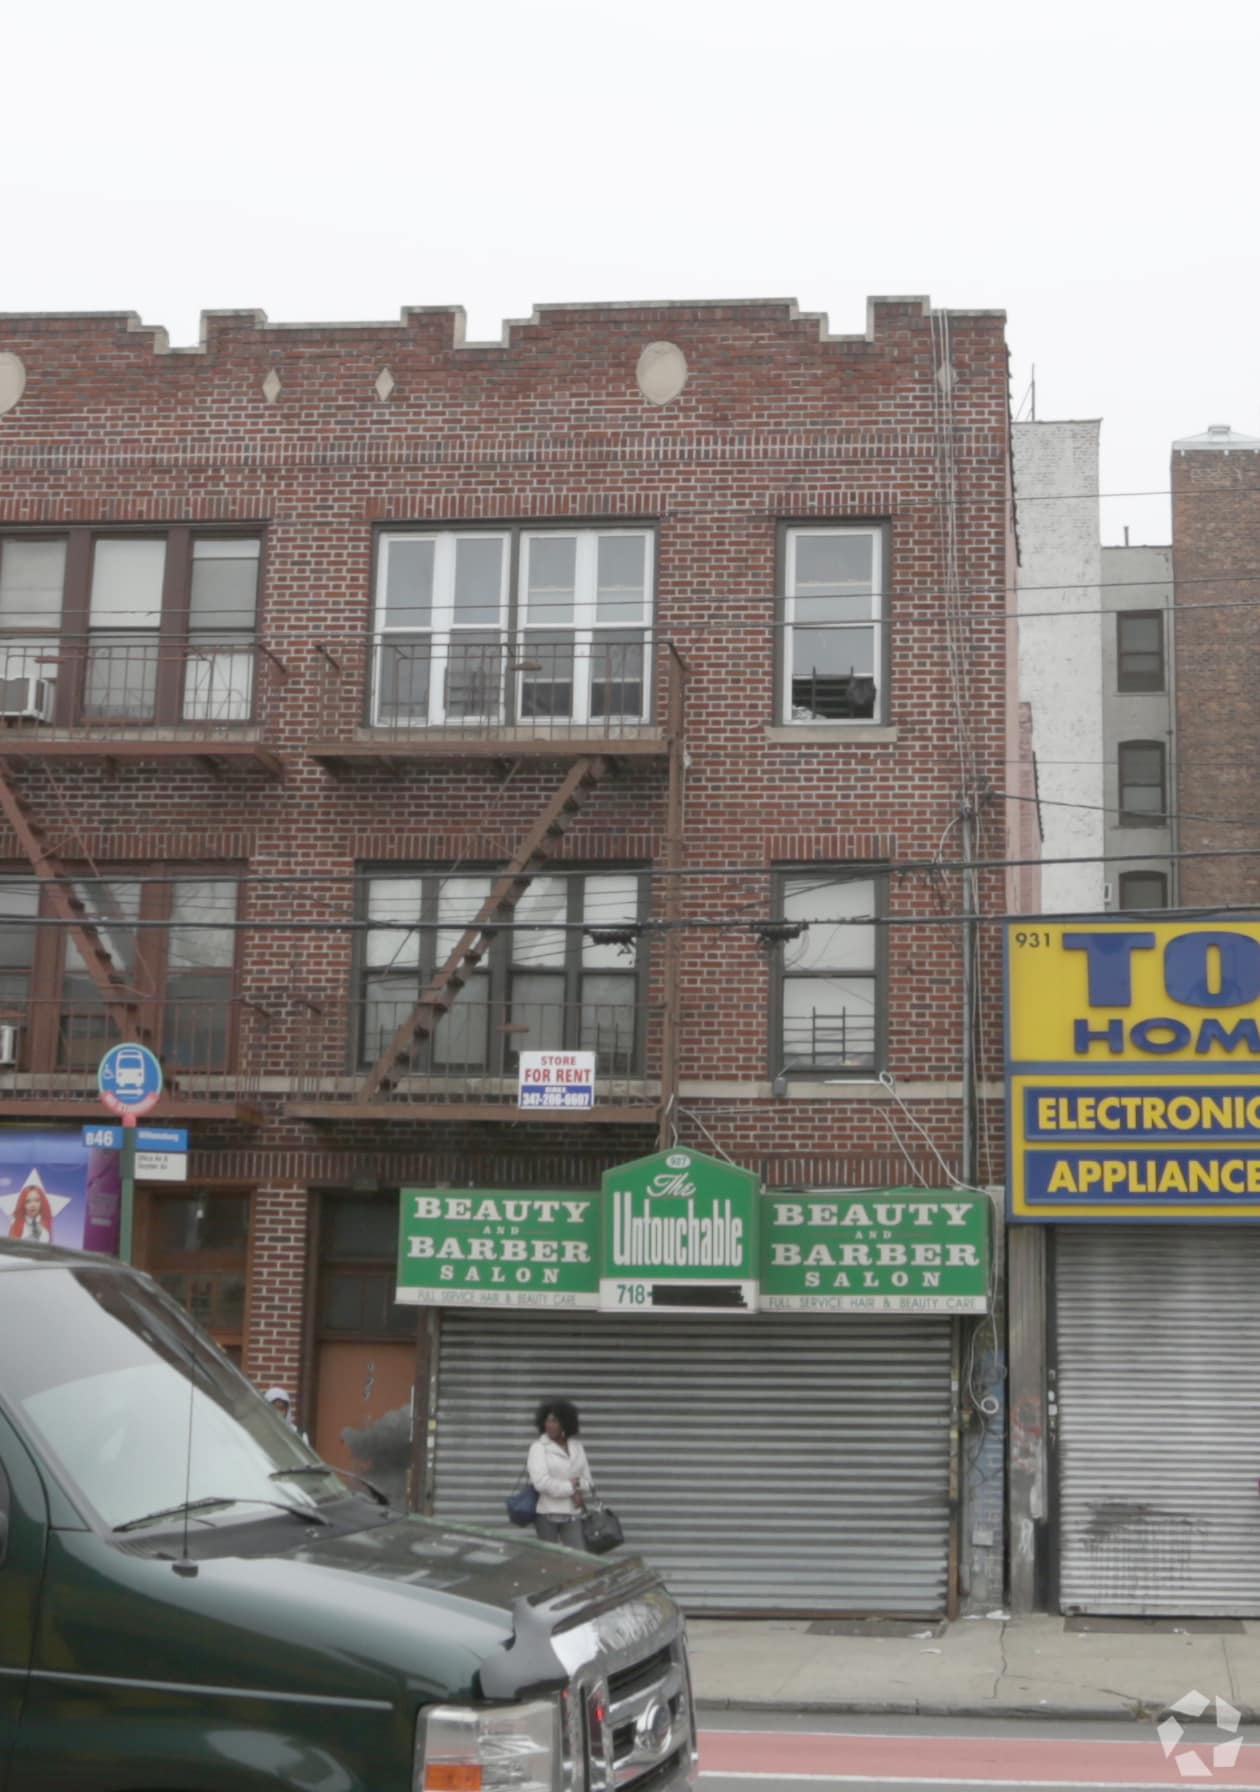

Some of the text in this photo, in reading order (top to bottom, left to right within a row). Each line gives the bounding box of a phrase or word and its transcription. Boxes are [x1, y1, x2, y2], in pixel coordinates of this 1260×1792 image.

[1015, 932, 1051, 948] 931
[1073, 1017, 1260, 1055] HOM
[541, 1055, 577, 1066] STORE
[524, 1068, 592, 1083] FOR RENT
[85, 1130, 114, 1147] B46
[646, 1171, 697, 1198] The
[1047, 1159, 1260, 1193] APPLIANCE
[413, 1197, 590, 1224] BEAUTY
[773, 1203, 974, 1226] BEAUTY
[482, 1226, 520, 1236] AND
[612, 1191, 743, 1267] Untouchable
[855, 1231, 892, 1239] AND
[407, 1236, 591, 1263] BARBER
[771, 1243, 980, 1266] BARBER
[439, 1264, 560, 1284] SALON
[804, 1271, 941, 1288] SALON
[441, 1291, 475, 1301] SERVICE
[481, 1293, 499, 1303] HAIR
[517, 1294, 548, 1304] BEAUTY
[553, 1295, 577, 1306] CARE
[769, 1297, 976, 1309] FULL SERVICE HAIR & BEAUTY CARE
